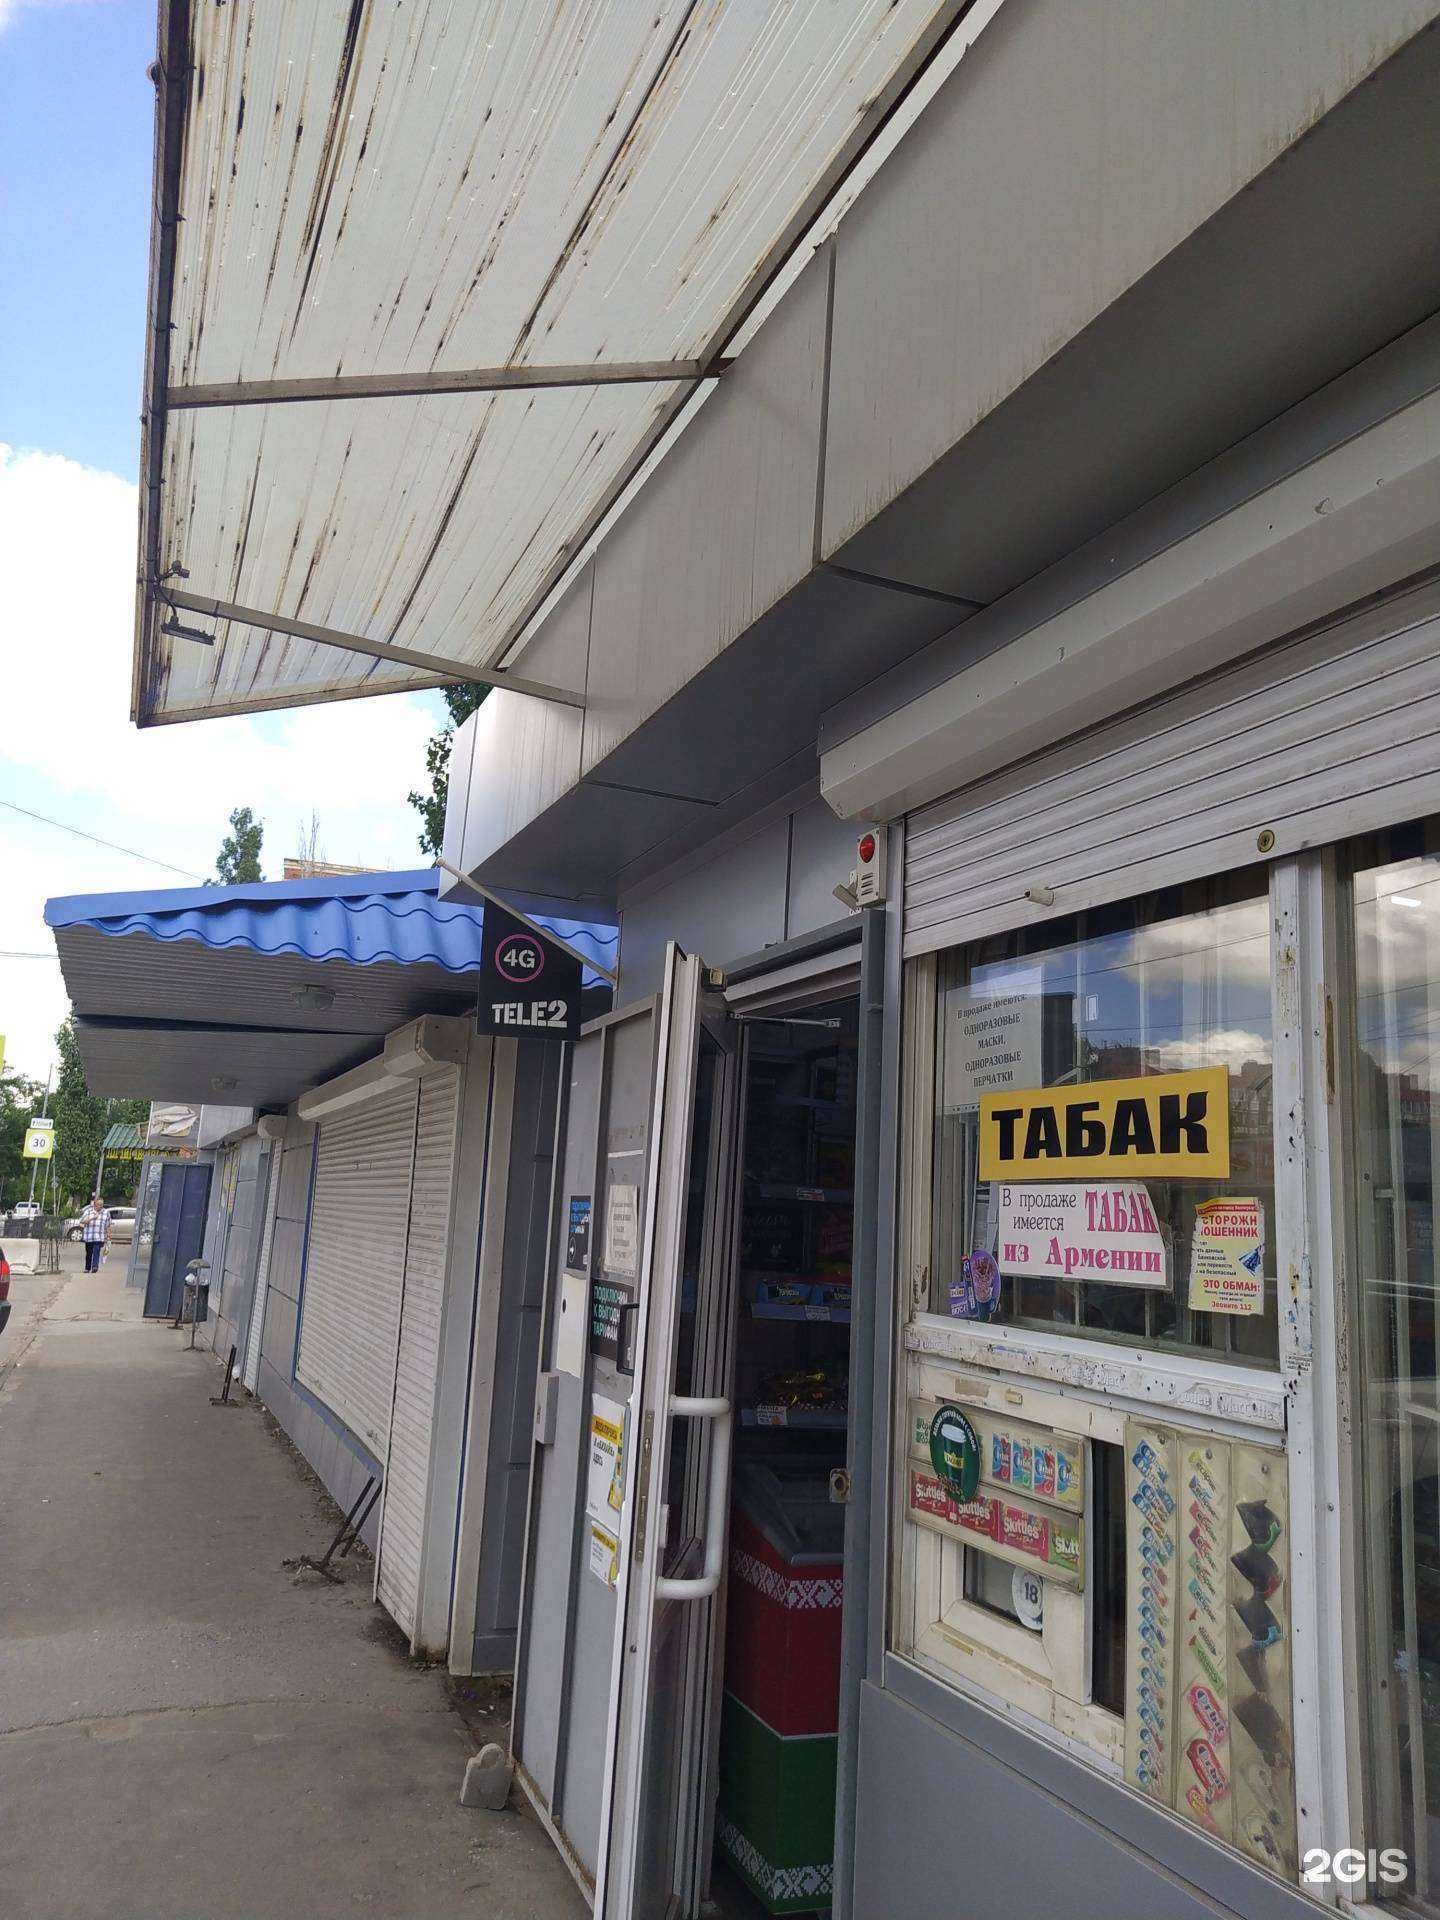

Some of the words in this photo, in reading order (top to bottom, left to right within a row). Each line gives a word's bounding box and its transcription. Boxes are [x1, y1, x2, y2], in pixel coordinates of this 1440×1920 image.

[503, 948, 536, 969] 4G
[491, 1000, 568, 1028] TELE2
[963, 1003, 992, 1019] продаже
[963, 1012, 1021, 1036] ОДНОРАЗОВЫЕ
[964, 1051, 1022, 1073] ОДНОРАЗОВЫЕ
[972, 1070, 1014, 1088] ПЕРЧАТКИ
[992, 1091, 1209, 1160] ТАБАК
[33, 1138, 46, 1148] 30
[1002, 1188, 1011, 1207] В
[1019, 1192, 1077, 1212] продаже
[1013, 1216, 1064, 1231] имеется
[1201, 1215, 1258, 1226] СТОРОЖН
[1201, 1226, 1259, 1238] ОШЕННИК
[1003, 1243, 1030, 1263] из
[1045, 1236, 1162, 1275] Армении
[1203, 1280, 1220, 1289] ЭТО
[1240, 1303, 1252, 1311] 112
[915, 1483, 946, 1502] Skittles
[958, 1501, 991, 1520] Skittles
[1003, 1518, 1039, 1538] Skittles
[1025, 1582, 1038, 1604] 18
